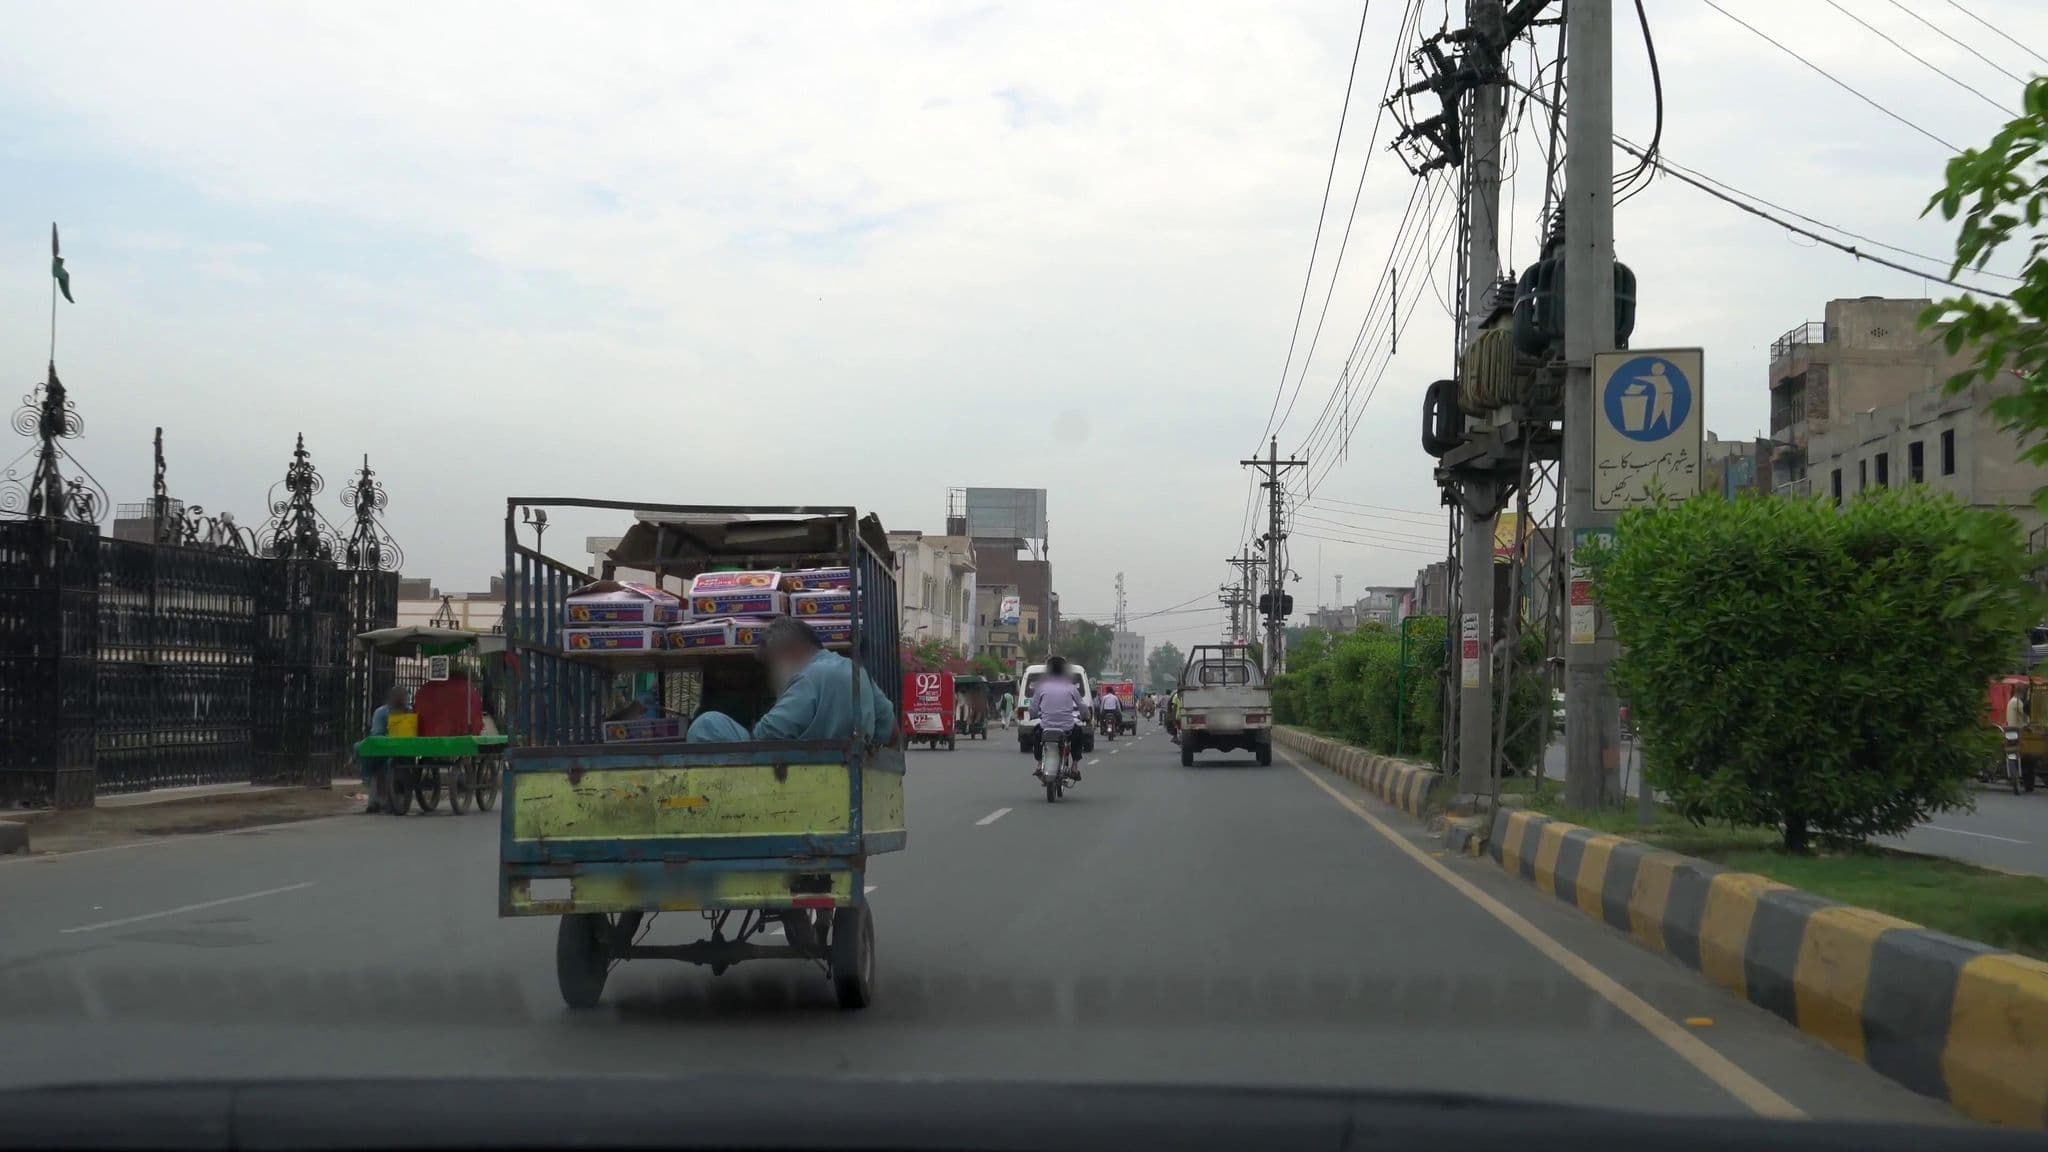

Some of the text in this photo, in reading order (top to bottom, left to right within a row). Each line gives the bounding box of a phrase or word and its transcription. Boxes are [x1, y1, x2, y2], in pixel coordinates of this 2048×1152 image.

[1598, 459, 1618, 477] ہے
[1621, 451, 1633, 469] کا
[1630, 459, 1657, 473] سب
[917, 674, 940, 695] 92
